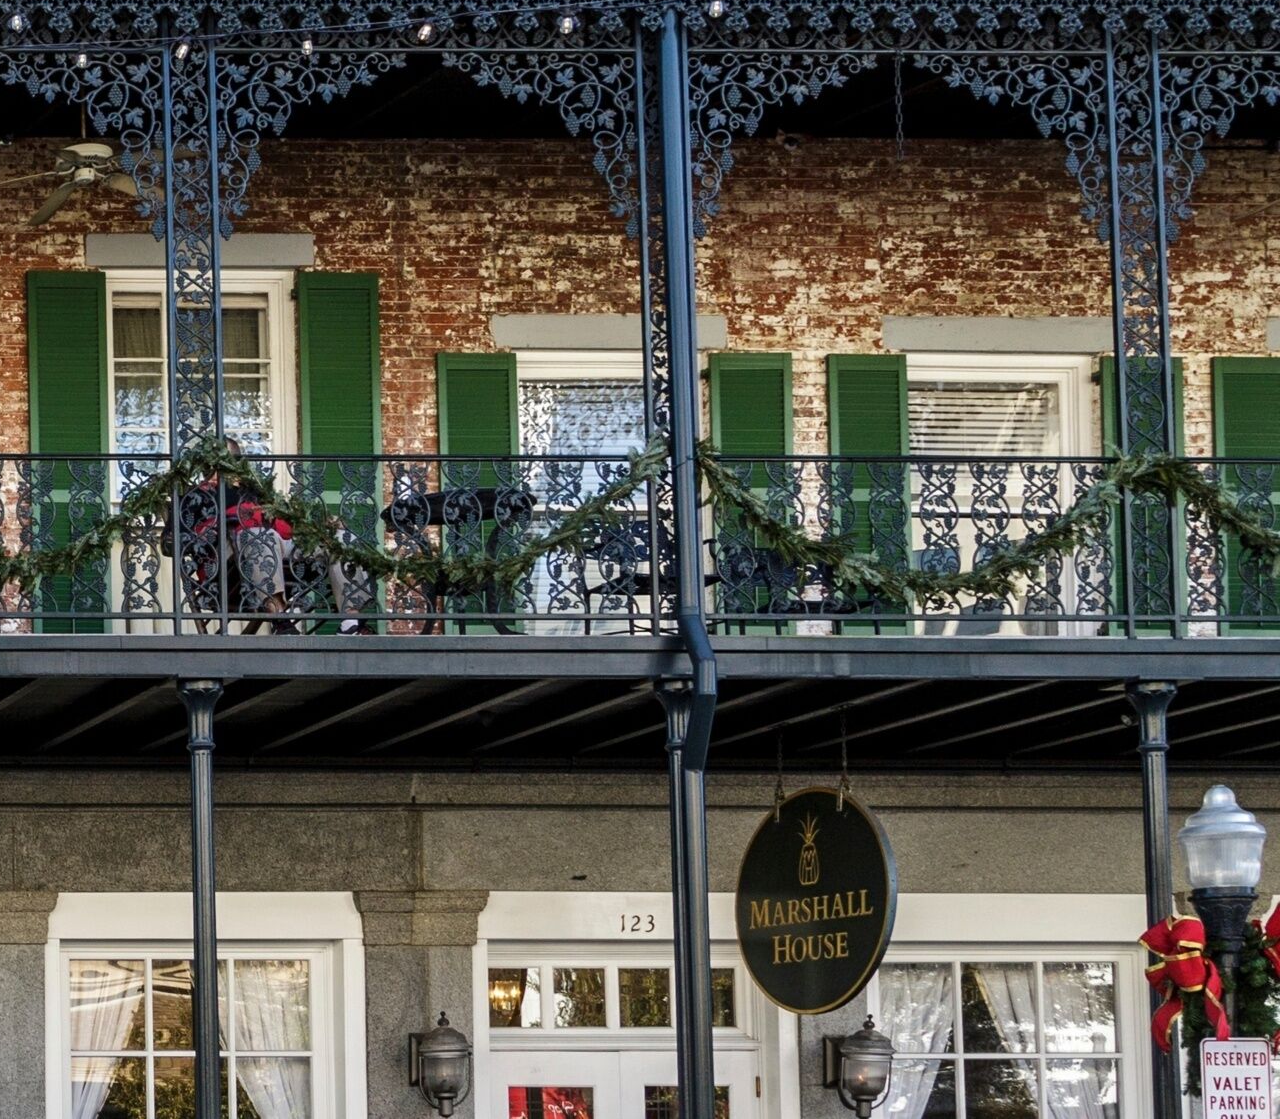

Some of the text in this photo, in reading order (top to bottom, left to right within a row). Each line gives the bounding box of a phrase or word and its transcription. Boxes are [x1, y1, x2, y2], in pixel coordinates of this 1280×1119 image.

[749, 889, 874, 929] MARSHALL
[620, 914, 656, 933] 123
[772, 932, 849, 964] HOUSE
[1205, 1052, 1267, 1066] RESERVED
[1213, 1076, 1261, 1091] VALET
[1210, 1096, 1266, 1110] PARKING
